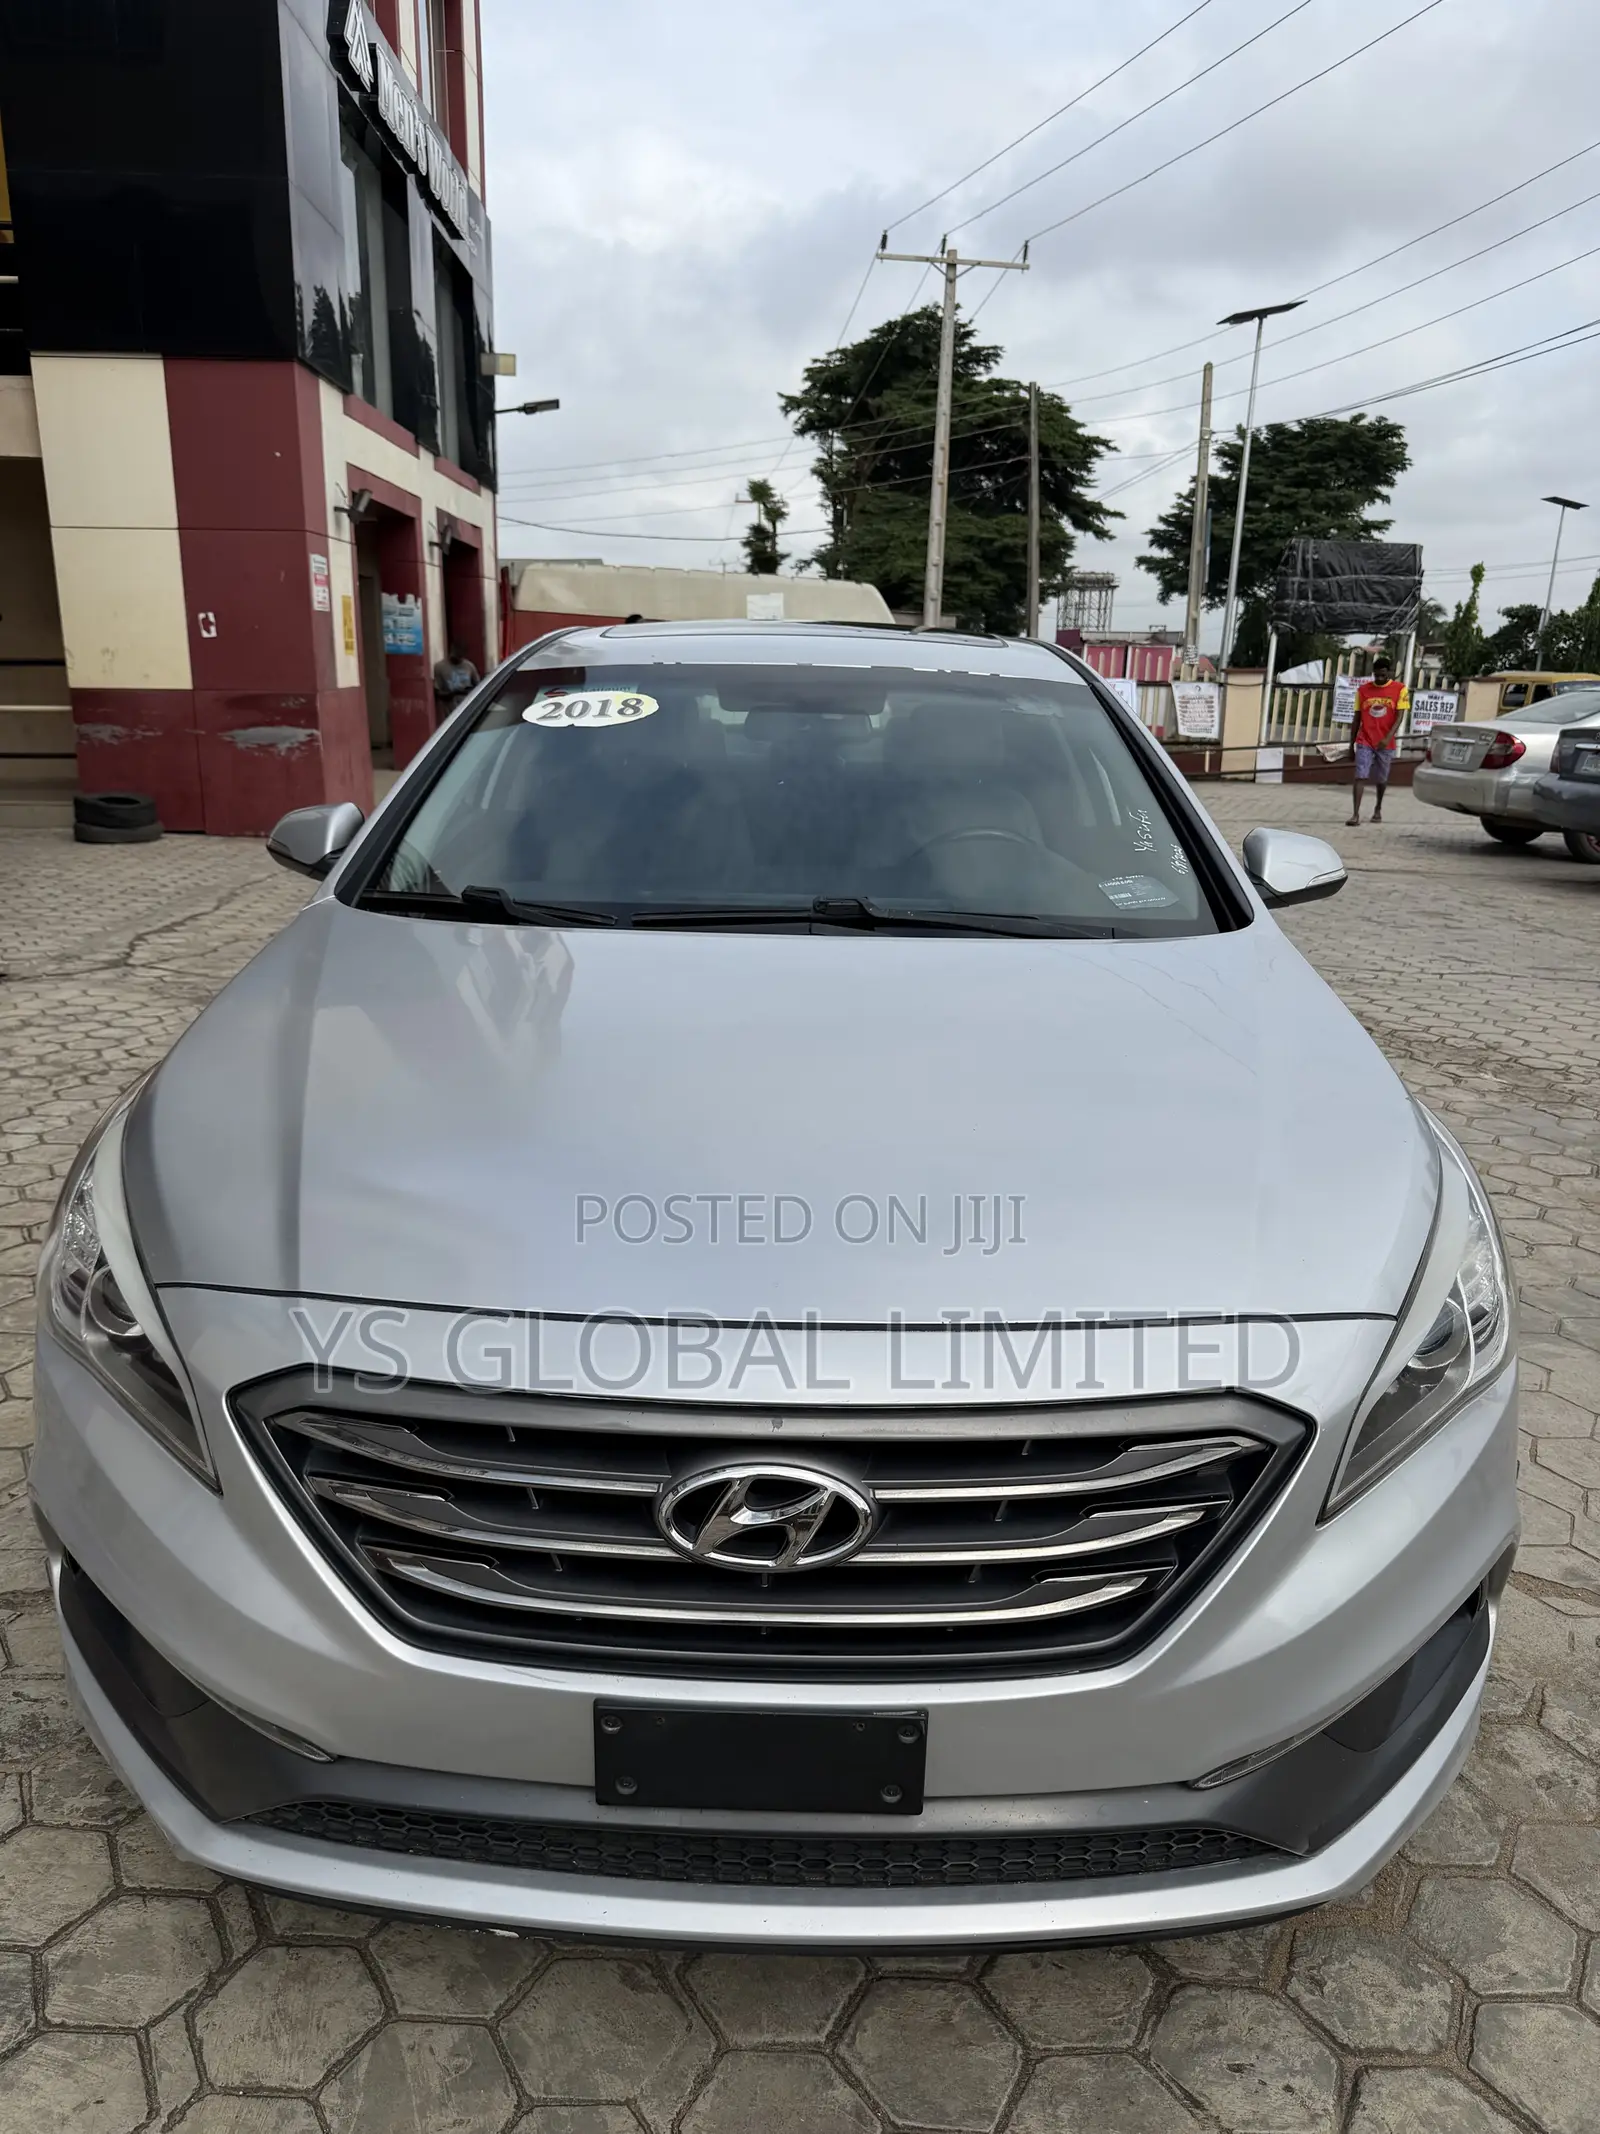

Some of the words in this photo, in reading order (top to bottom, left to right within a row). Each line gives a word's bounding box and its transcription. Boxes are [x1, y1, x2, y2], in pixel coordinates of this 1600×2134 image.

[376, 42, 428, 177] Men's
[535, 697, 645, 722] 2018
[1414, 700, 1439, 712] SALES
